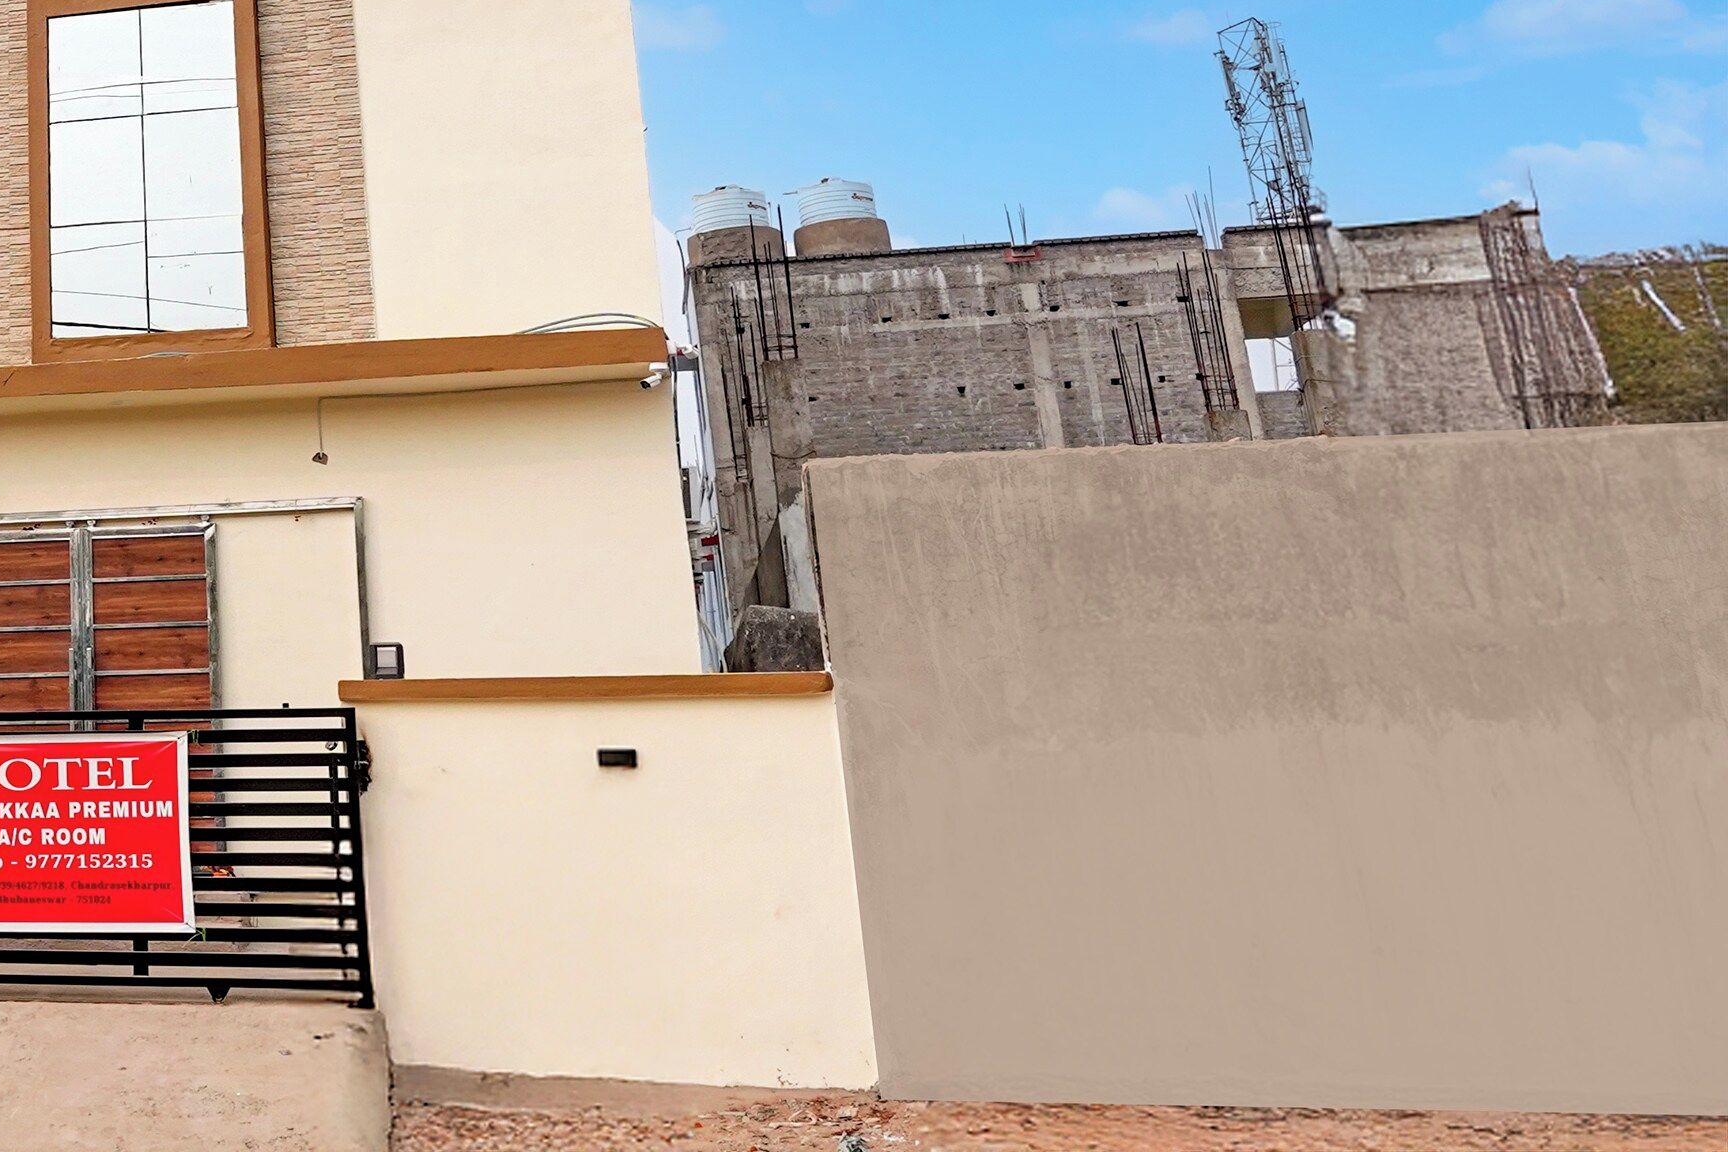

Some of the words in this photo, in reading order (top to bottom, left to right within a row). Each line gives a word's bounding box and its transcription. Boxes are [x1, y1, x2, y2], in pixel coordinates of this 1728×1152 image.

[68, 800, 173, 818] PREMIUM
[41, 827, 106, 845] ROOM
[25, 853, 153, 869] 9777152315
